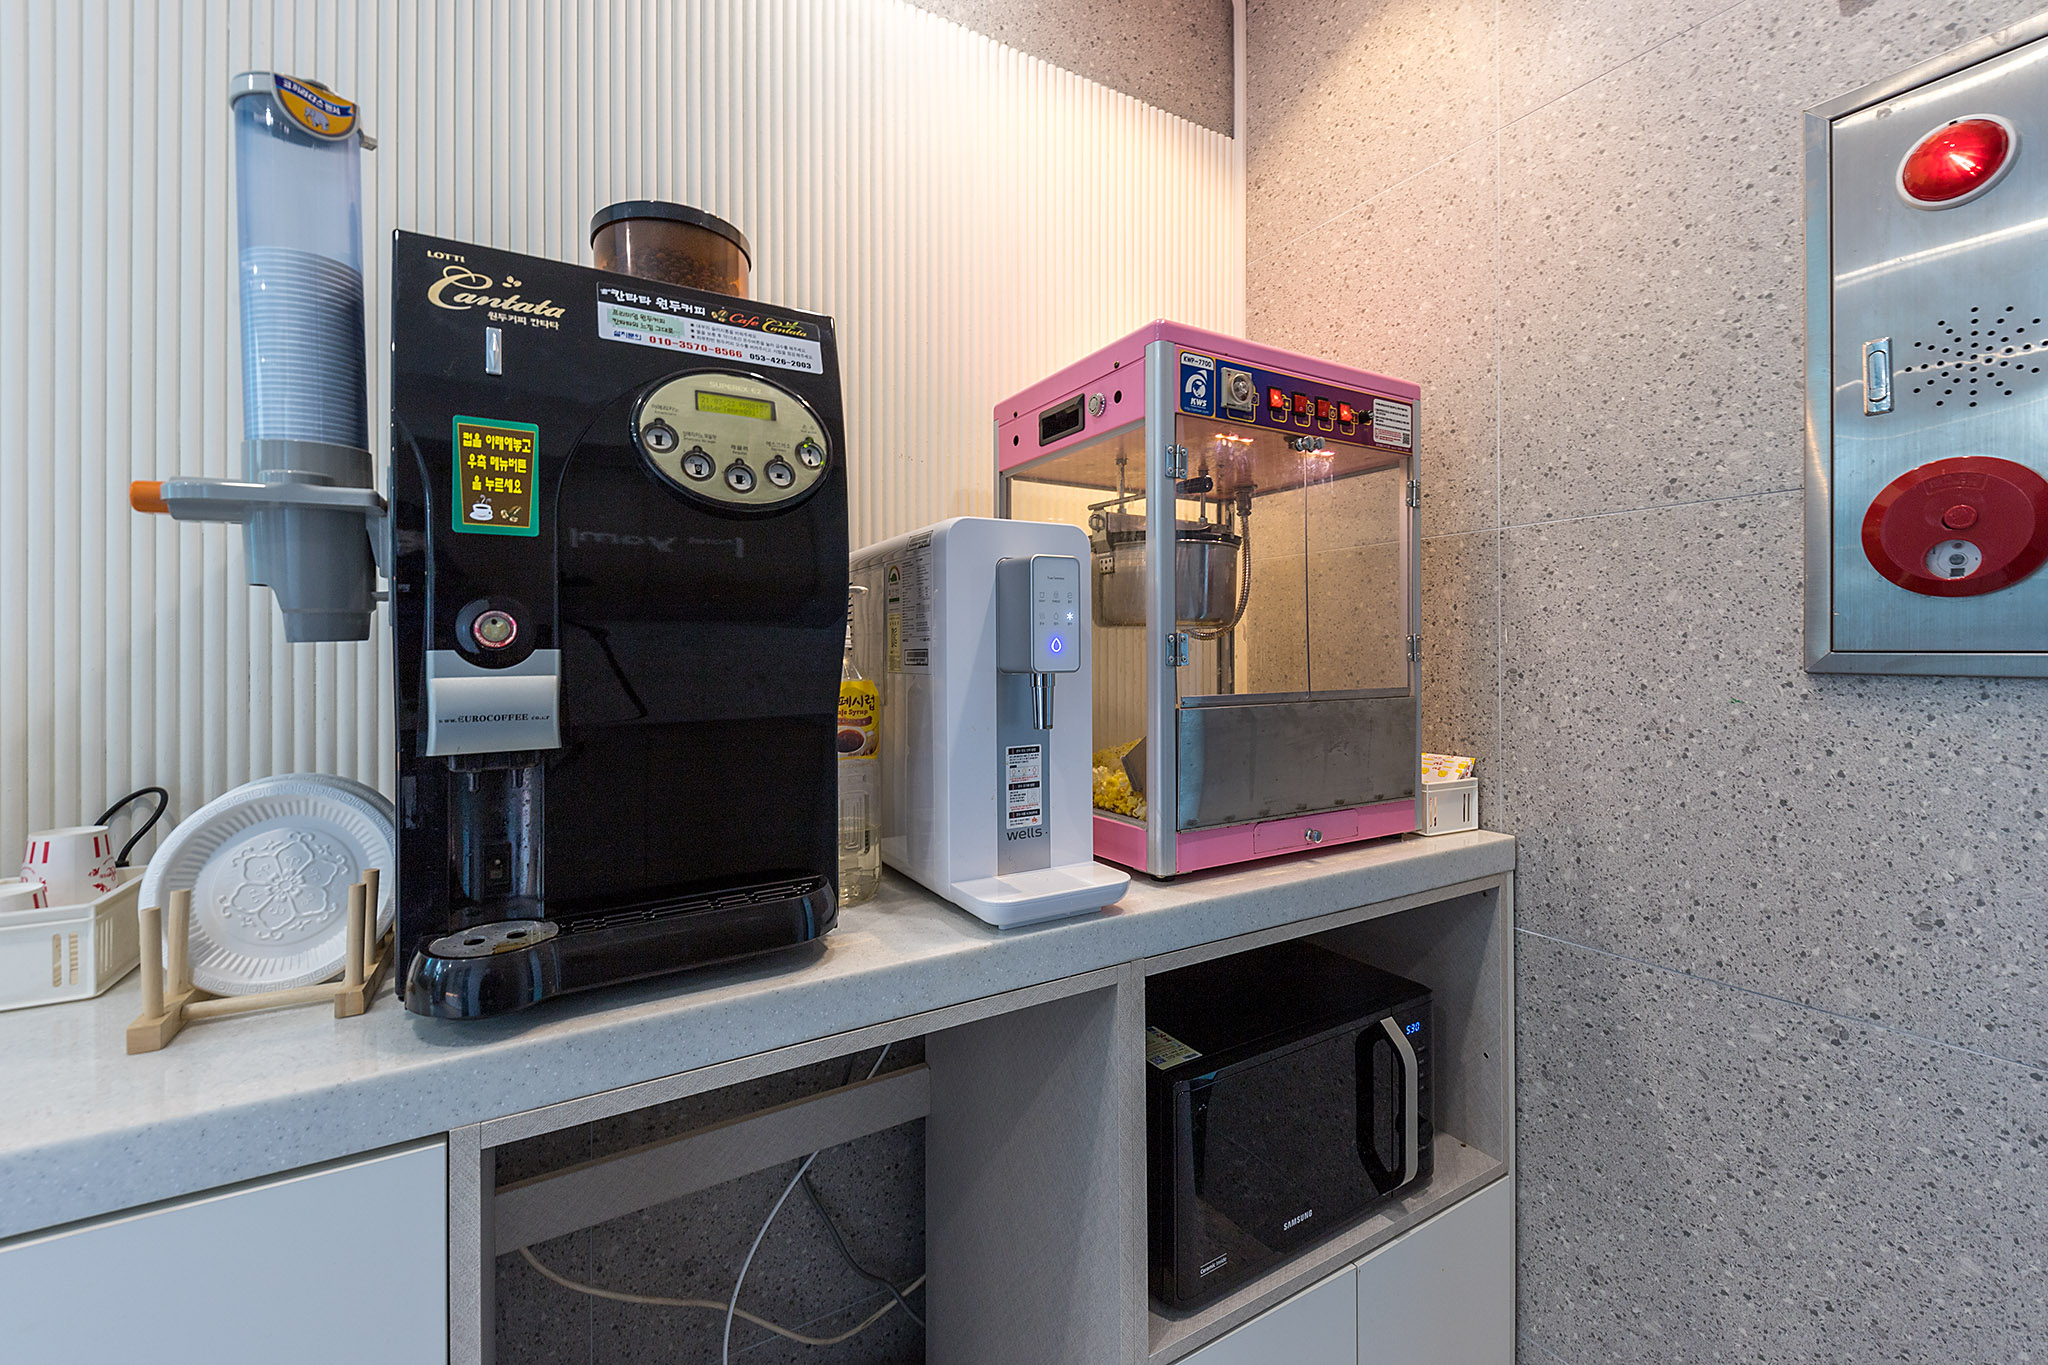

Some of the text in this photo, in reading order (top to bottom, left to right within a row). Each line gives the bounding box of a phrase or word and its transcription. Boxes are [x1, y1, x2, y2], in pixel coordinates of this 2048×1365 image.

[427, 265, 566, 318] Cantata
[655, 297, 706, 316] 원두커피
[487, 311, 560, 330] 원두커피 칸타타
[729, 313, 808, 338] Cafe Cantata
[649, 335, 743, 359] 010-3570-8566
[749, 353, 813, 370] 053-426-2003
[1190, 397, 1207, 408] KWS
[462, 431, 531, 454] 컵을 아래에놓고
[467, 453, 527, 474] 우측 메뉴버튼
[472, 475, 523, 495] 을 누르세요
[848, 708, 868, 717] Syrup
[1006, 827, 1043, 841] wells
[1283, 1209, 1313, 1231] SAMSUNG
